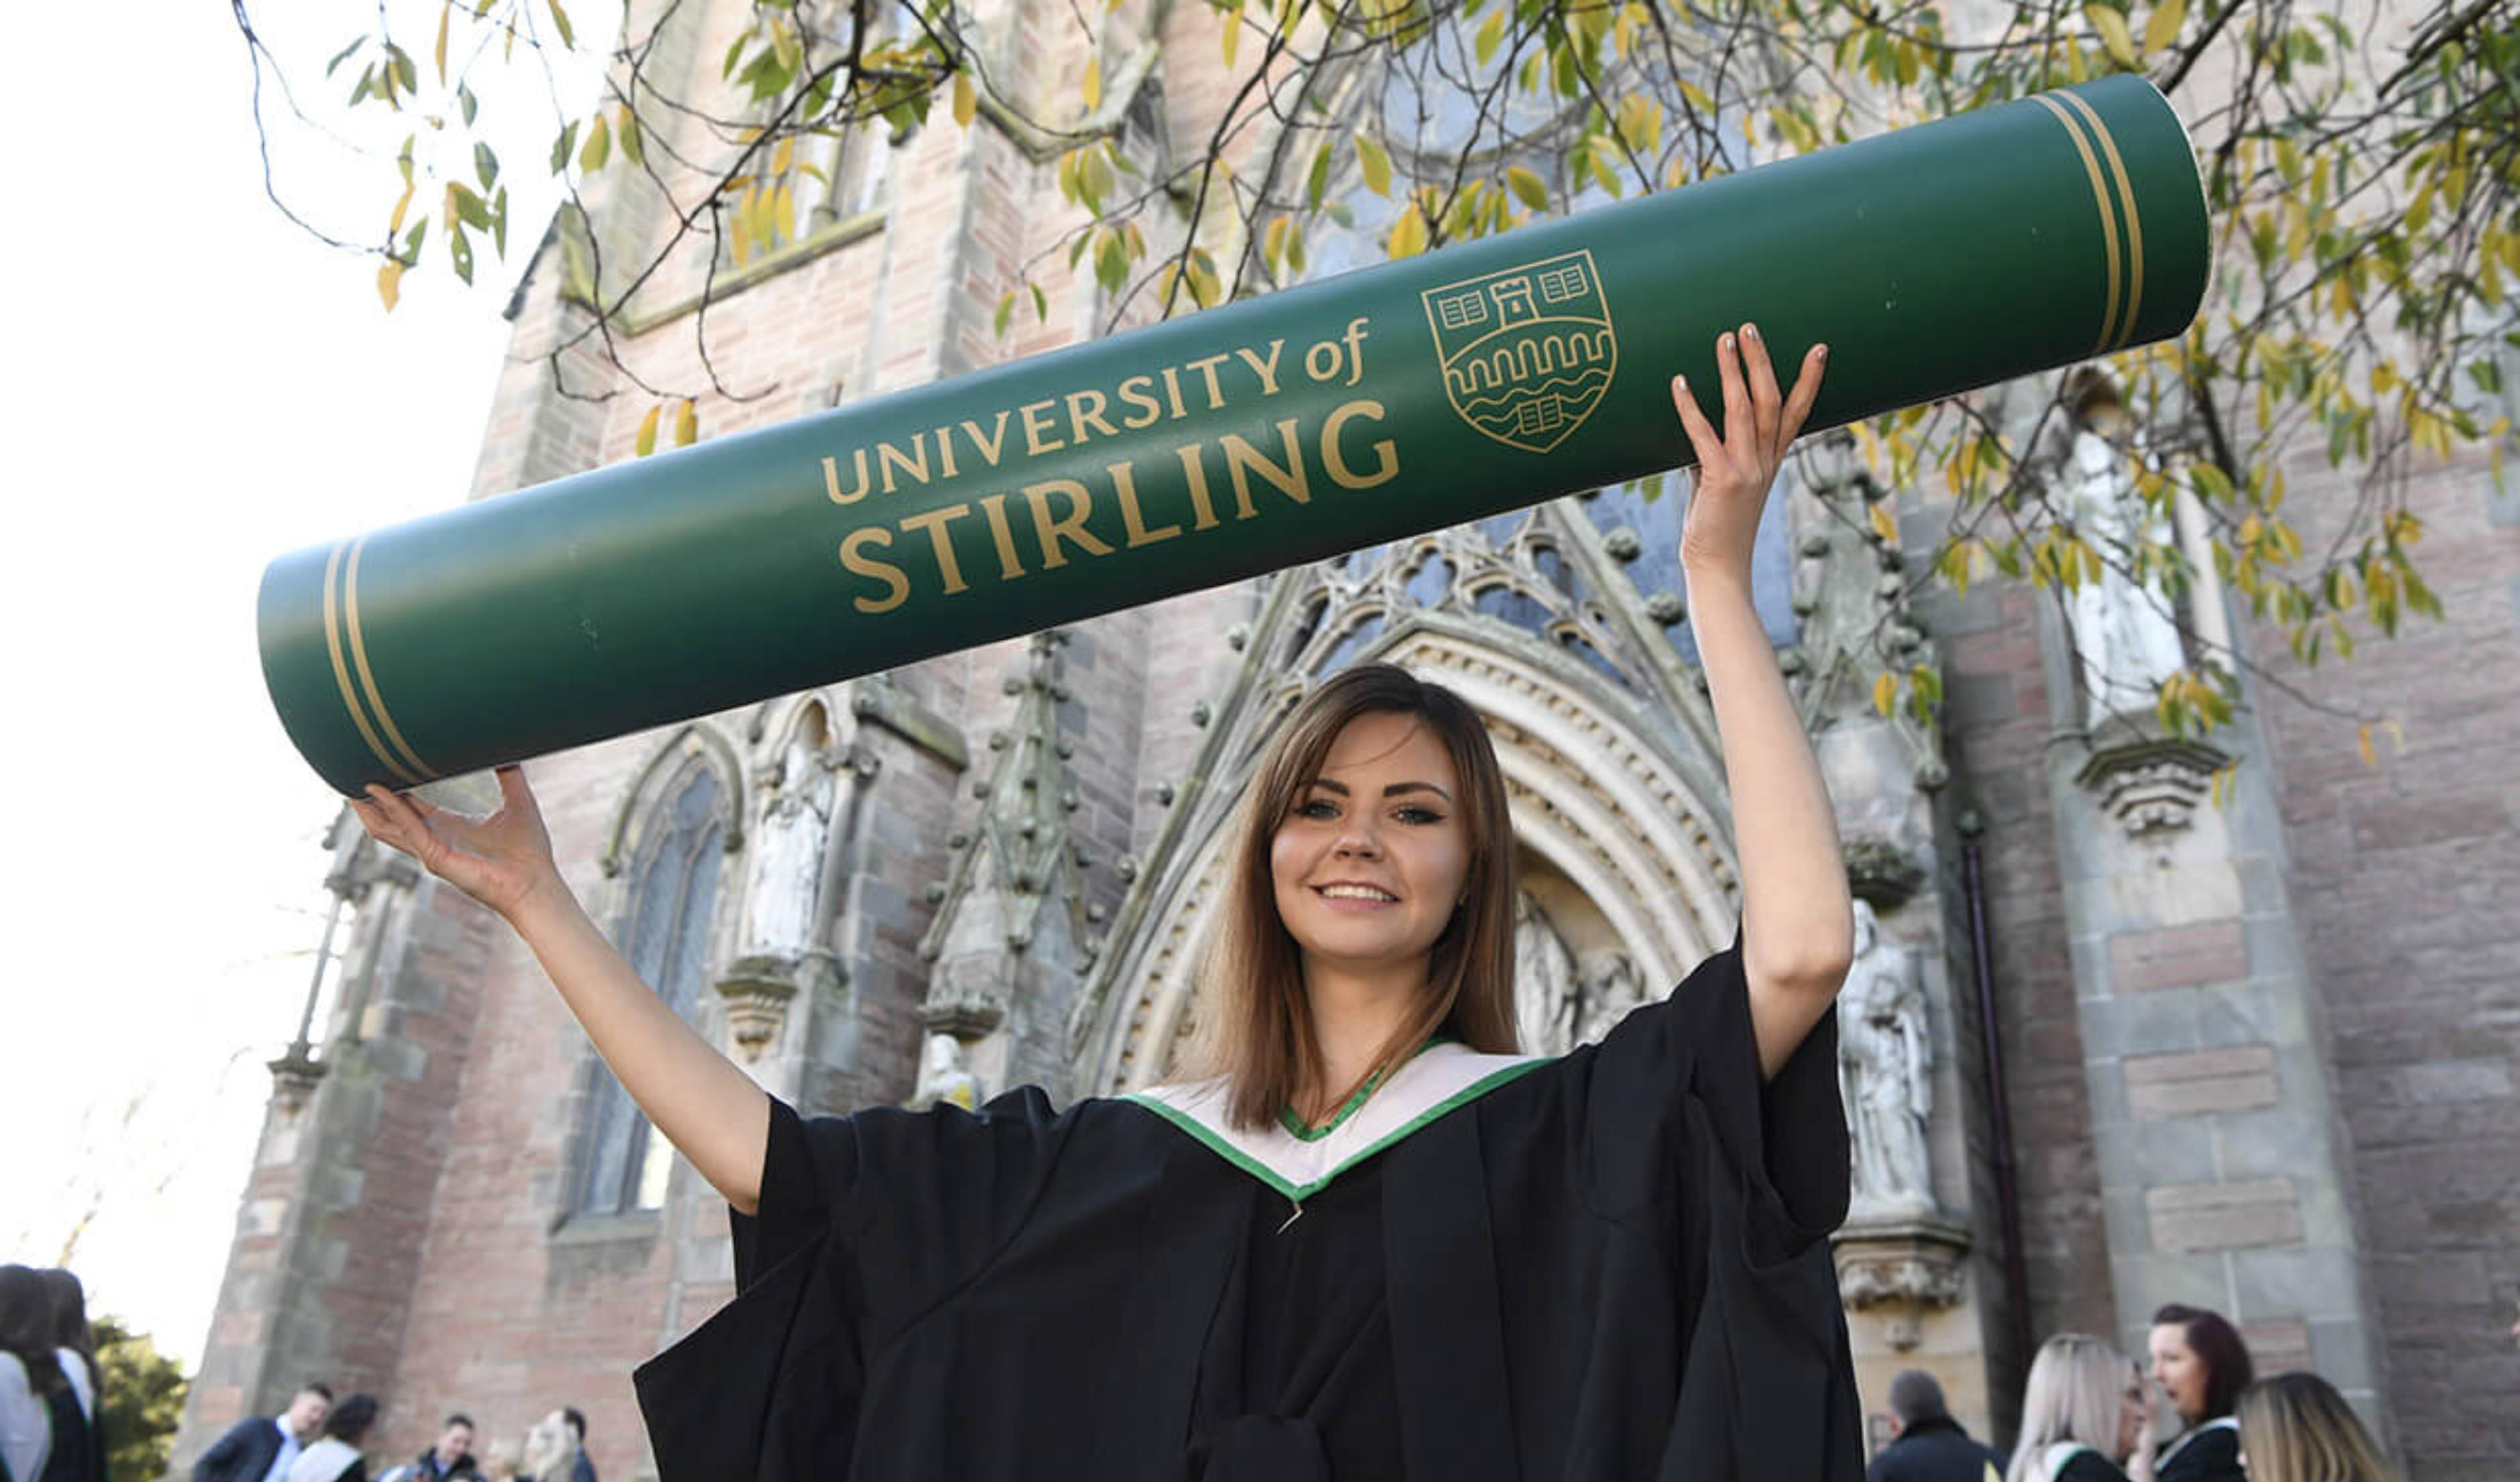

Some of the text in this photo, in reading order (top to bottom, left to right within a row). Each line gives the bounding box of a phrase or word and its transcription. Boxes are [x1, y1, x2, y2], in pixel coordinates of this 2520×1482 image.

[821, 317, 1369, 505] UNIVERSITY of
[839, 400, 1399, 613] STIRLING
